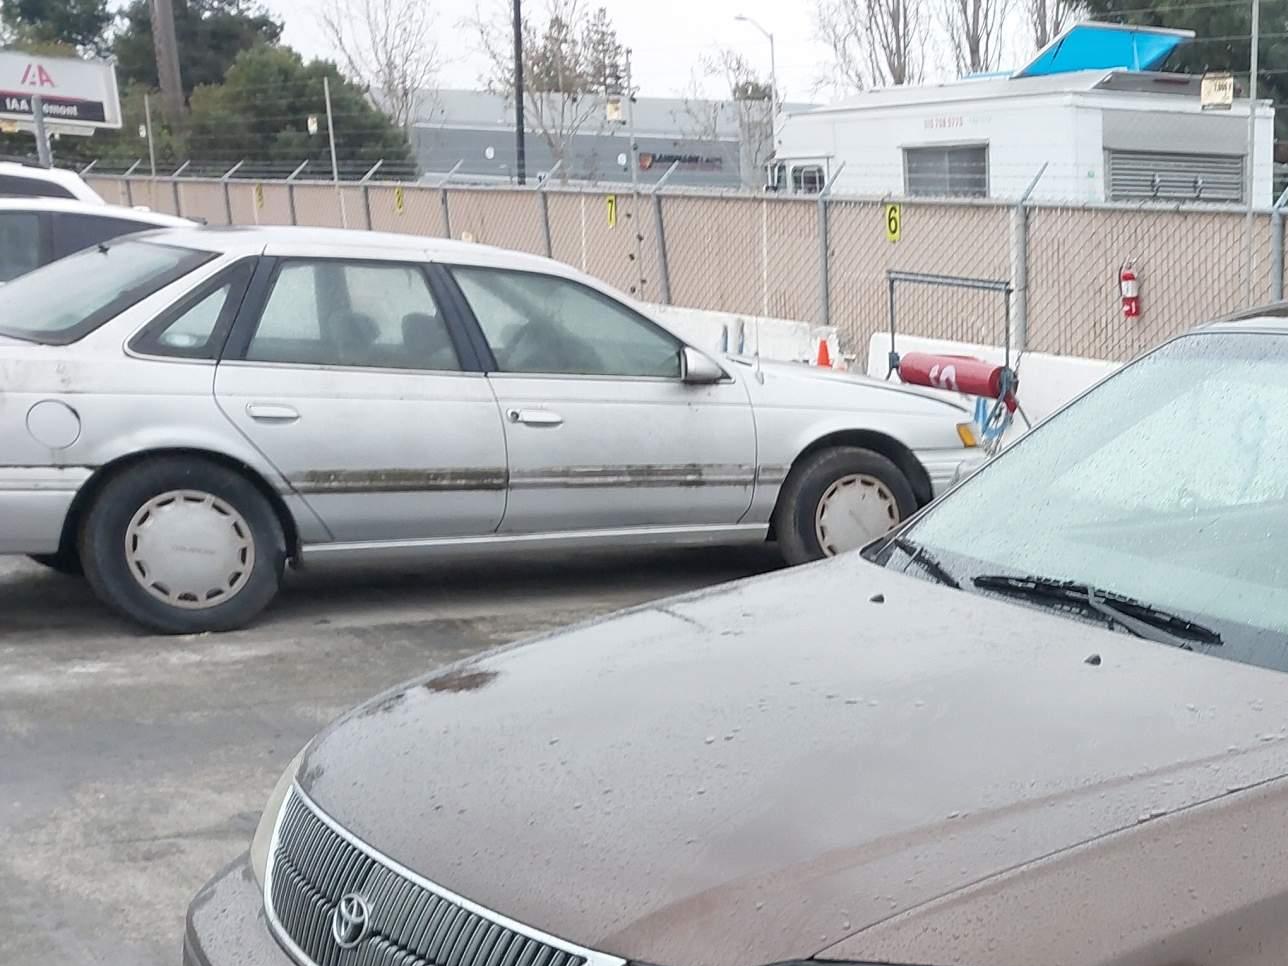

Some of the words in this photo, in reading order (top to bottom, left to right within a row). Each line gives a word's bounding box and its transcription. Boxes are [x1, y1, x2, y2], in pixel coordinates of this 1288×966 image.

[5, 97, 29, 111] IAA
[607, 199, 615, 222] 7
[888, 205, 898, 235] 6
